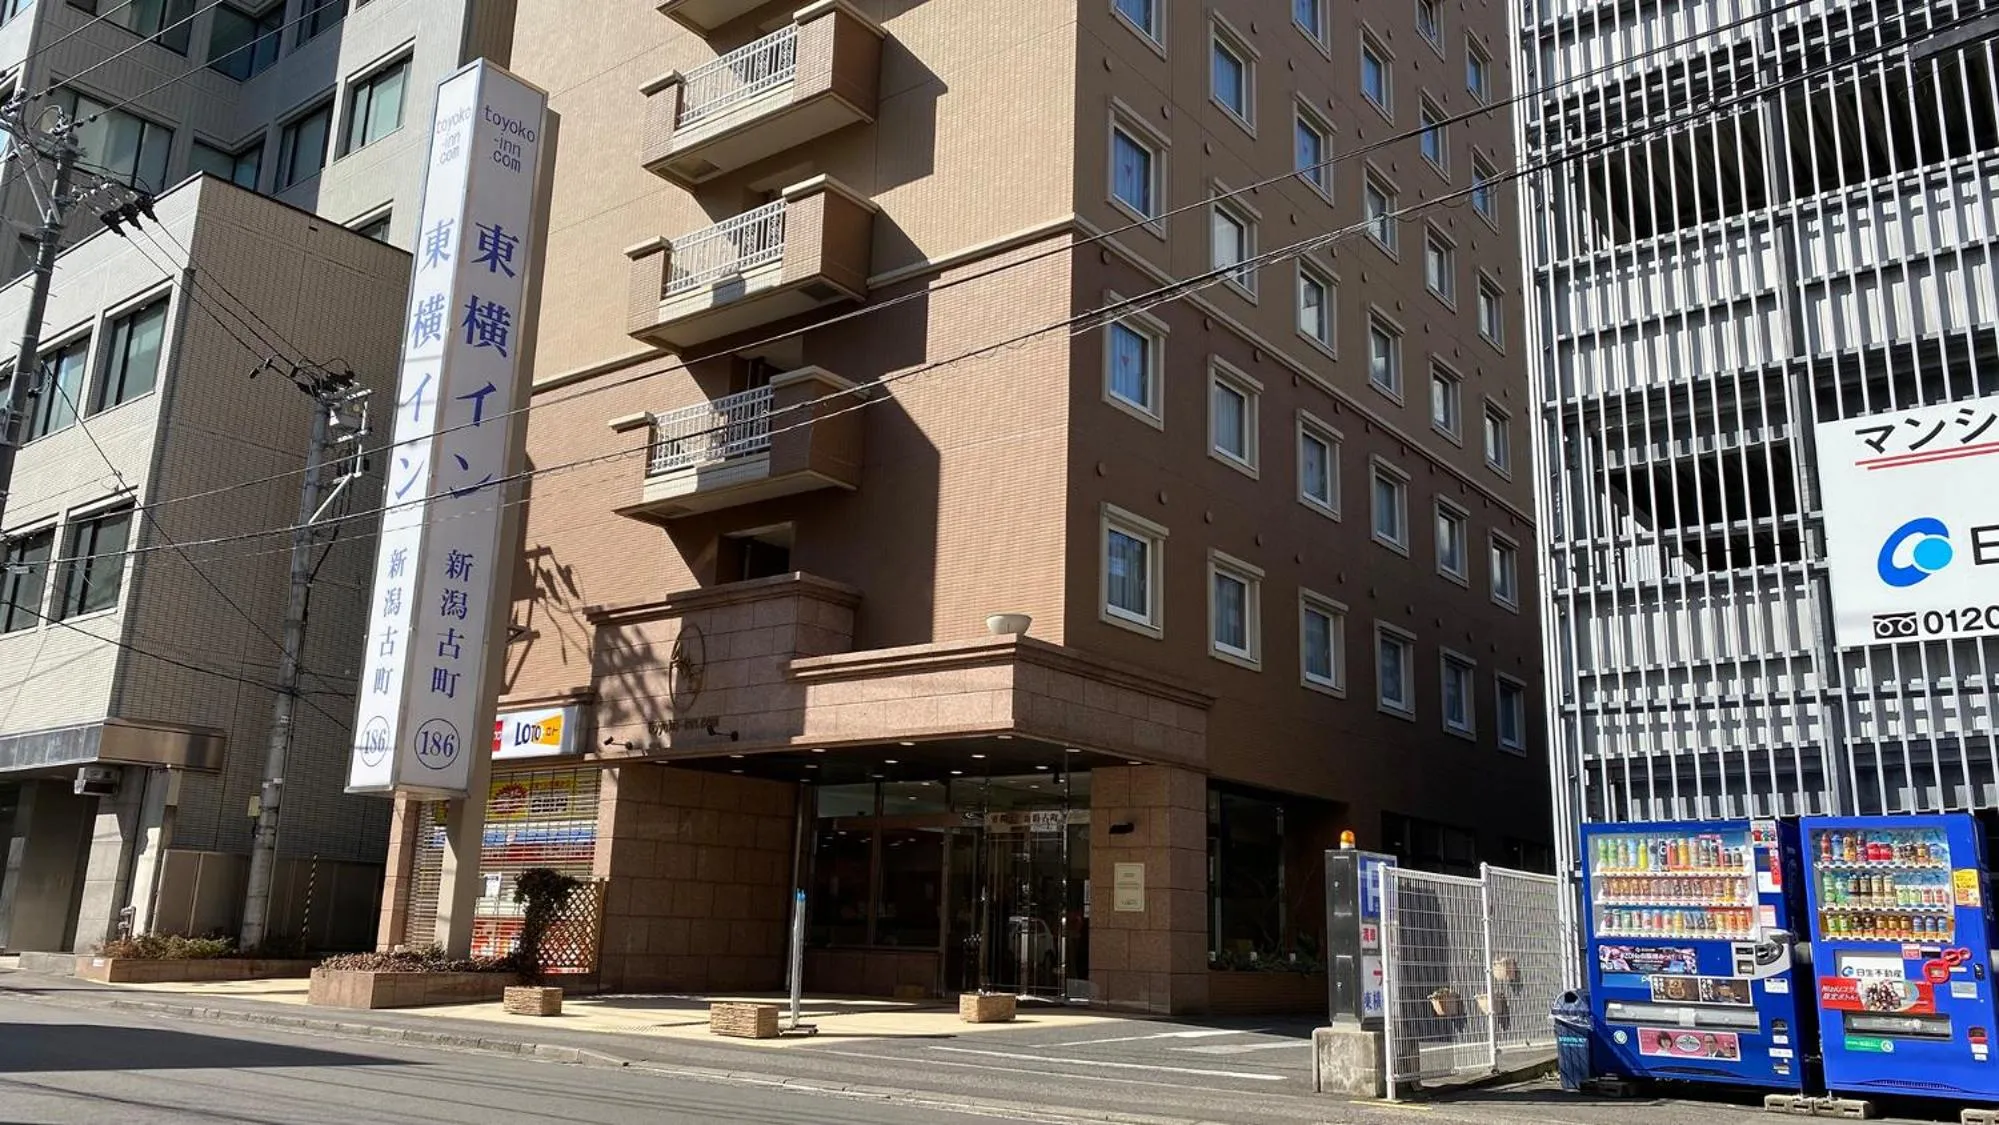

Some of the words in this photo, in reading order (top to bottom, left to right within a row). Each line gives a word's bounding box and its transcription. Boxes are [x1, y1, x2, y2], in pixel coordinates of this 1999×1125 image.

[436, 106, 472, 134] toyoko
[484, 104, 536, 143] toyoko
[493, 132, 521, 158] -inn
[489, 150, 521, 174] .com
[395, 217, 455, 502] 東横イン
[450, 220, 521, 501] 東横イン
[1854, 407, 1997, 454] マンシ
[373, 546, 408, 697] 新潟古町
[430, 548, 474, 700] 新潟古町
[1923, 605, 1999, 635] 0120
[364, 728, 386, 756] 186
[418, 729, 455, 758] 186
[514, 721, 542, 747] LOTO
